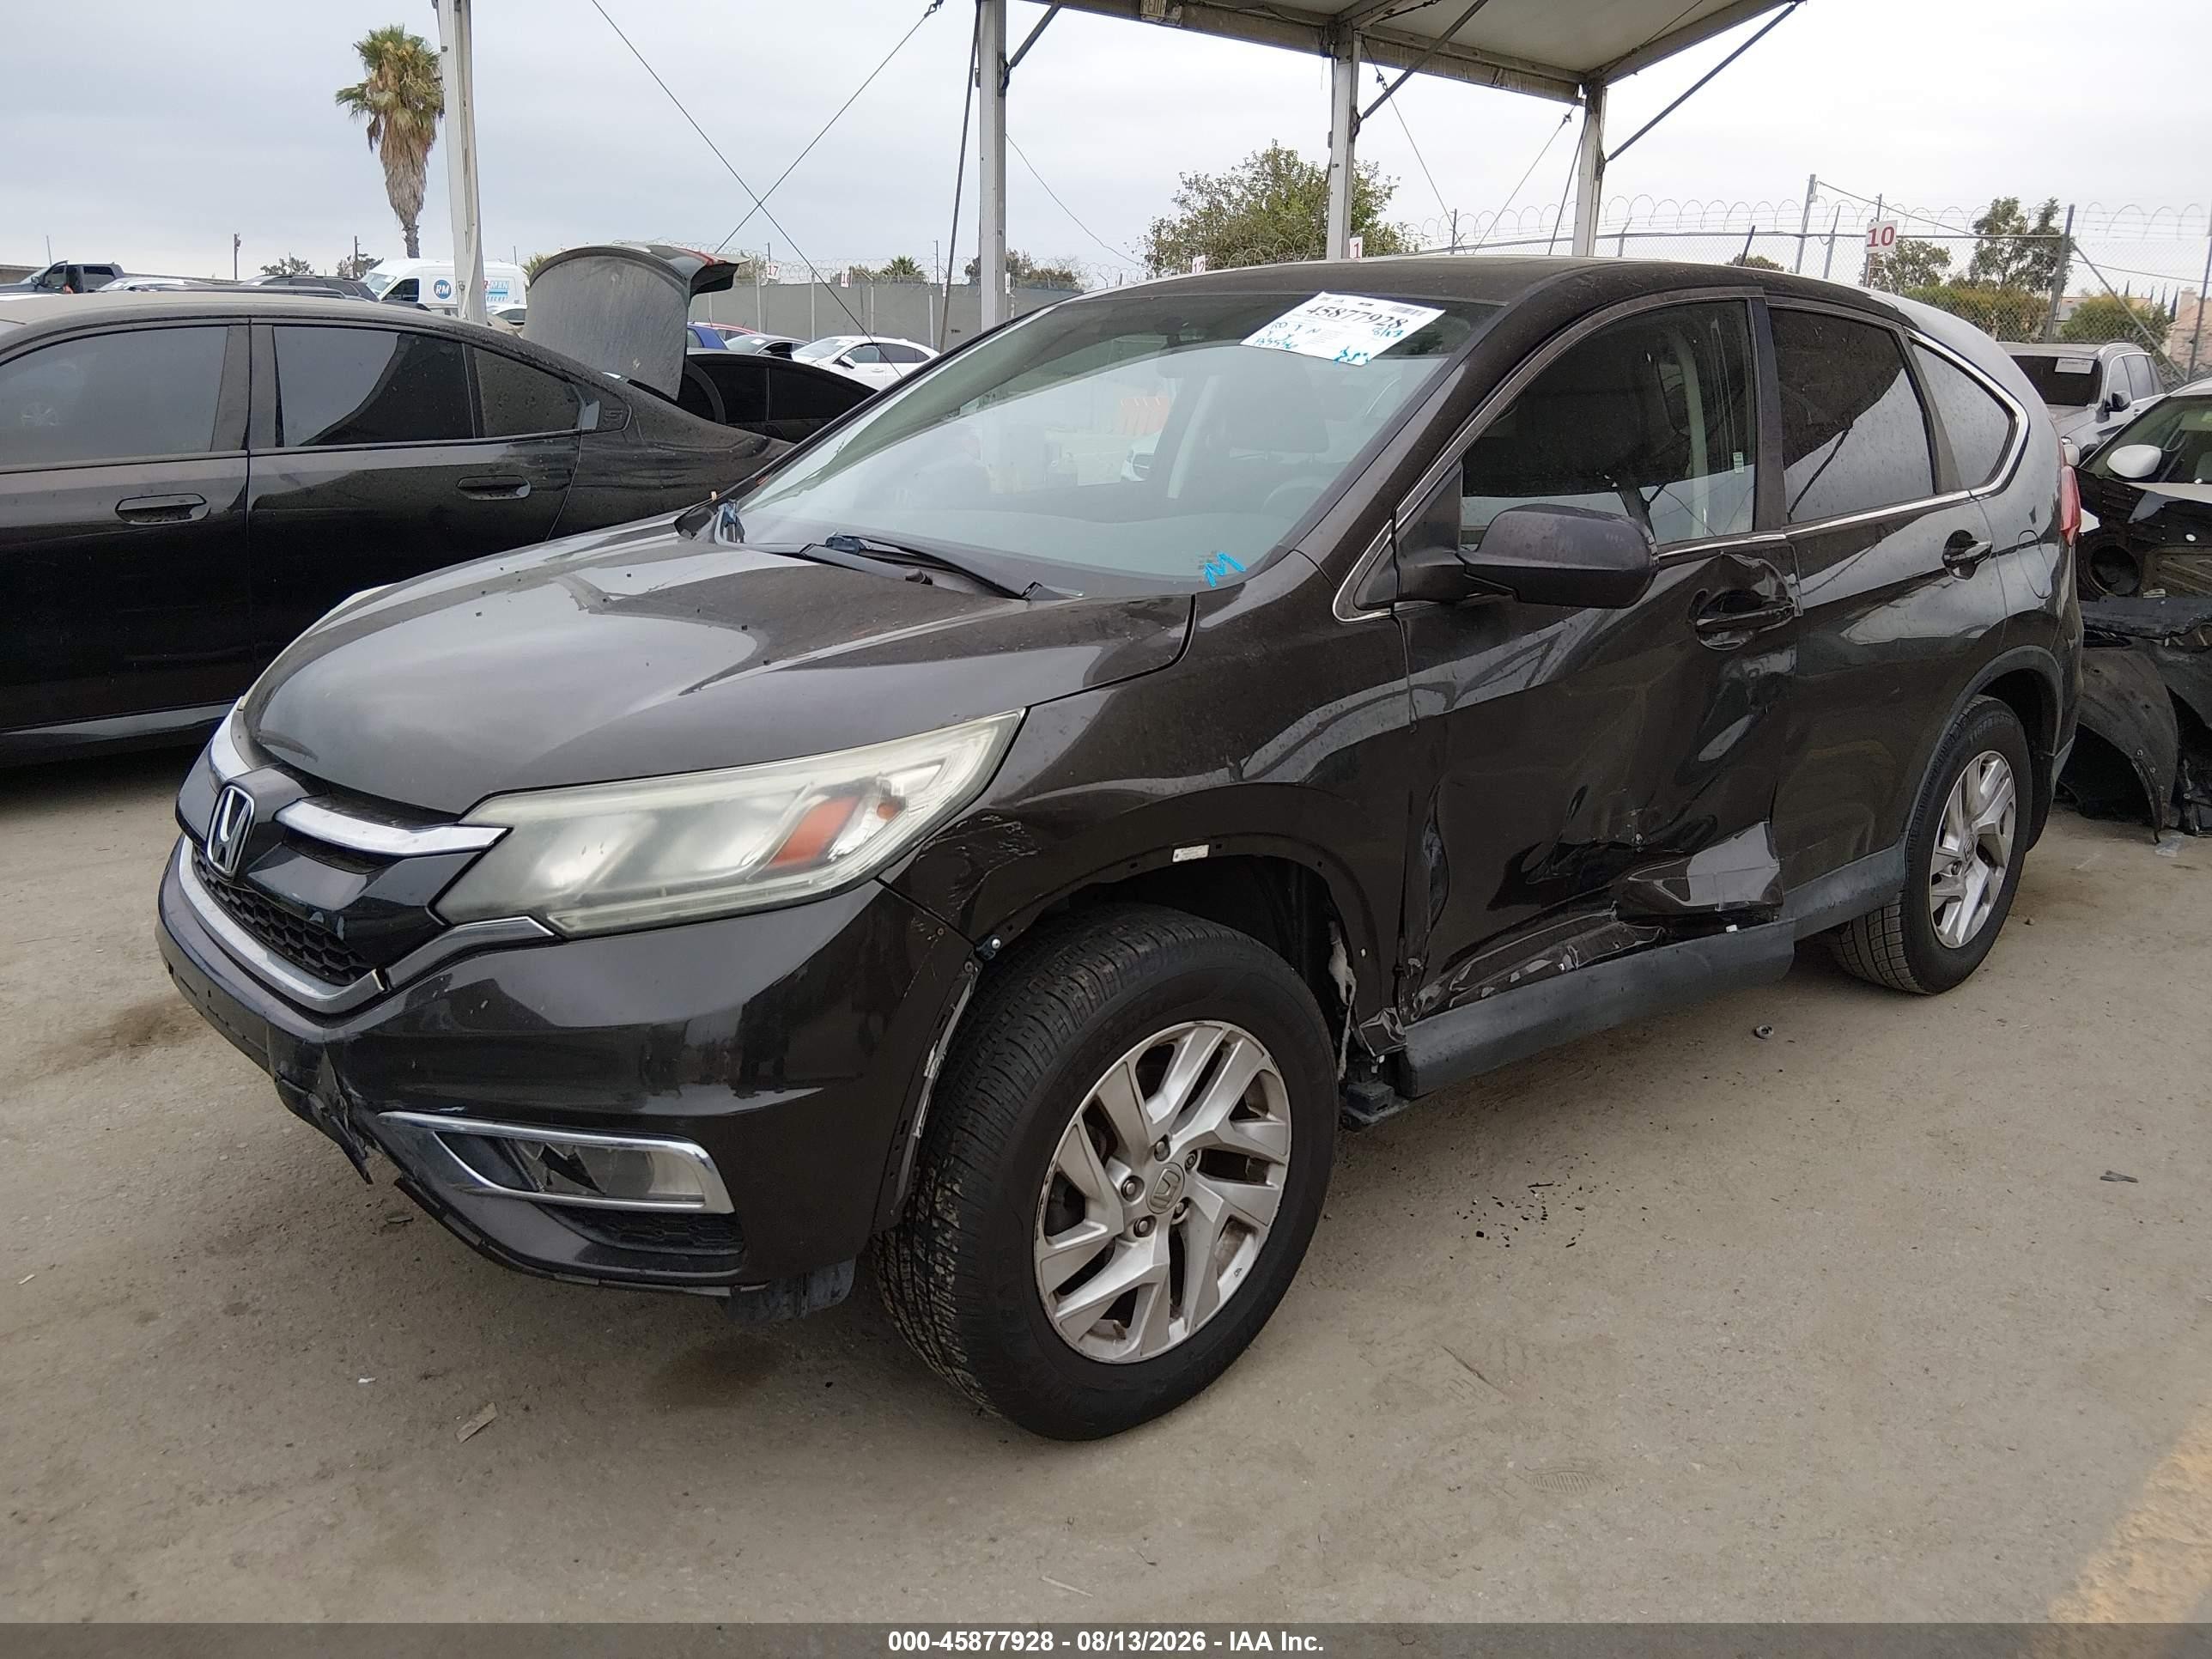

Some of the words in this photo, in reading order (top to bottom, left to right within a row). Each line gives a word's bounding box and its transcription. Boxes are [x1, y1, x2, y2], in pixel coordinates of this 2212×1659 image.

[1866, 226, 1894, 247] 10
[768, 264, 779, 276] 17
[1194, 260, 1205, 274] 12
[435, 284, 450, 295] RM
[1306, 305, 1409, 329] 45877928
